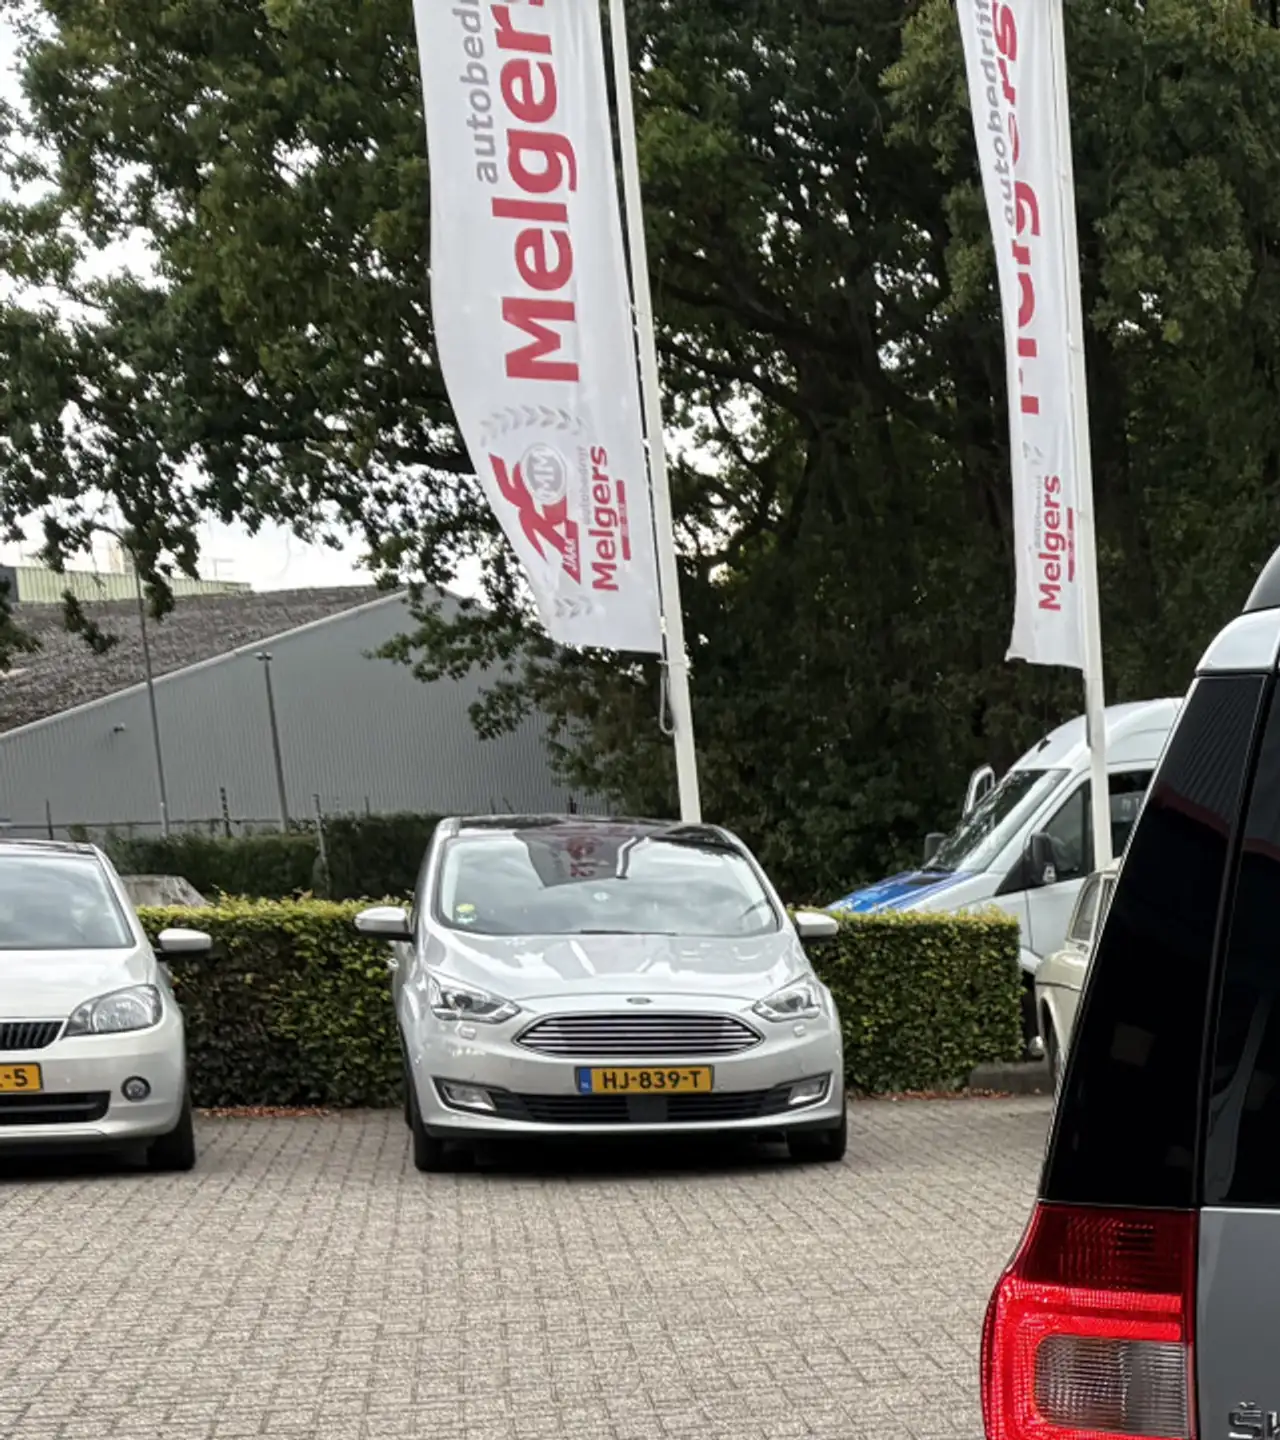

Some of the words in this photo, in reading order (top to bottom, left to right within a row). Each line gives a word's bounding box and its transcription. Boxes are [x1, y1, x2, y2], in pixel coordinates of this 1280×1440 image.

[491, 0, 580, 382] Melger
[588, 445, 620, 592] Melgers
[1037, 474, 1062, 611] Melgers
[602, 1071, 702, 1090] HJ-839-T
